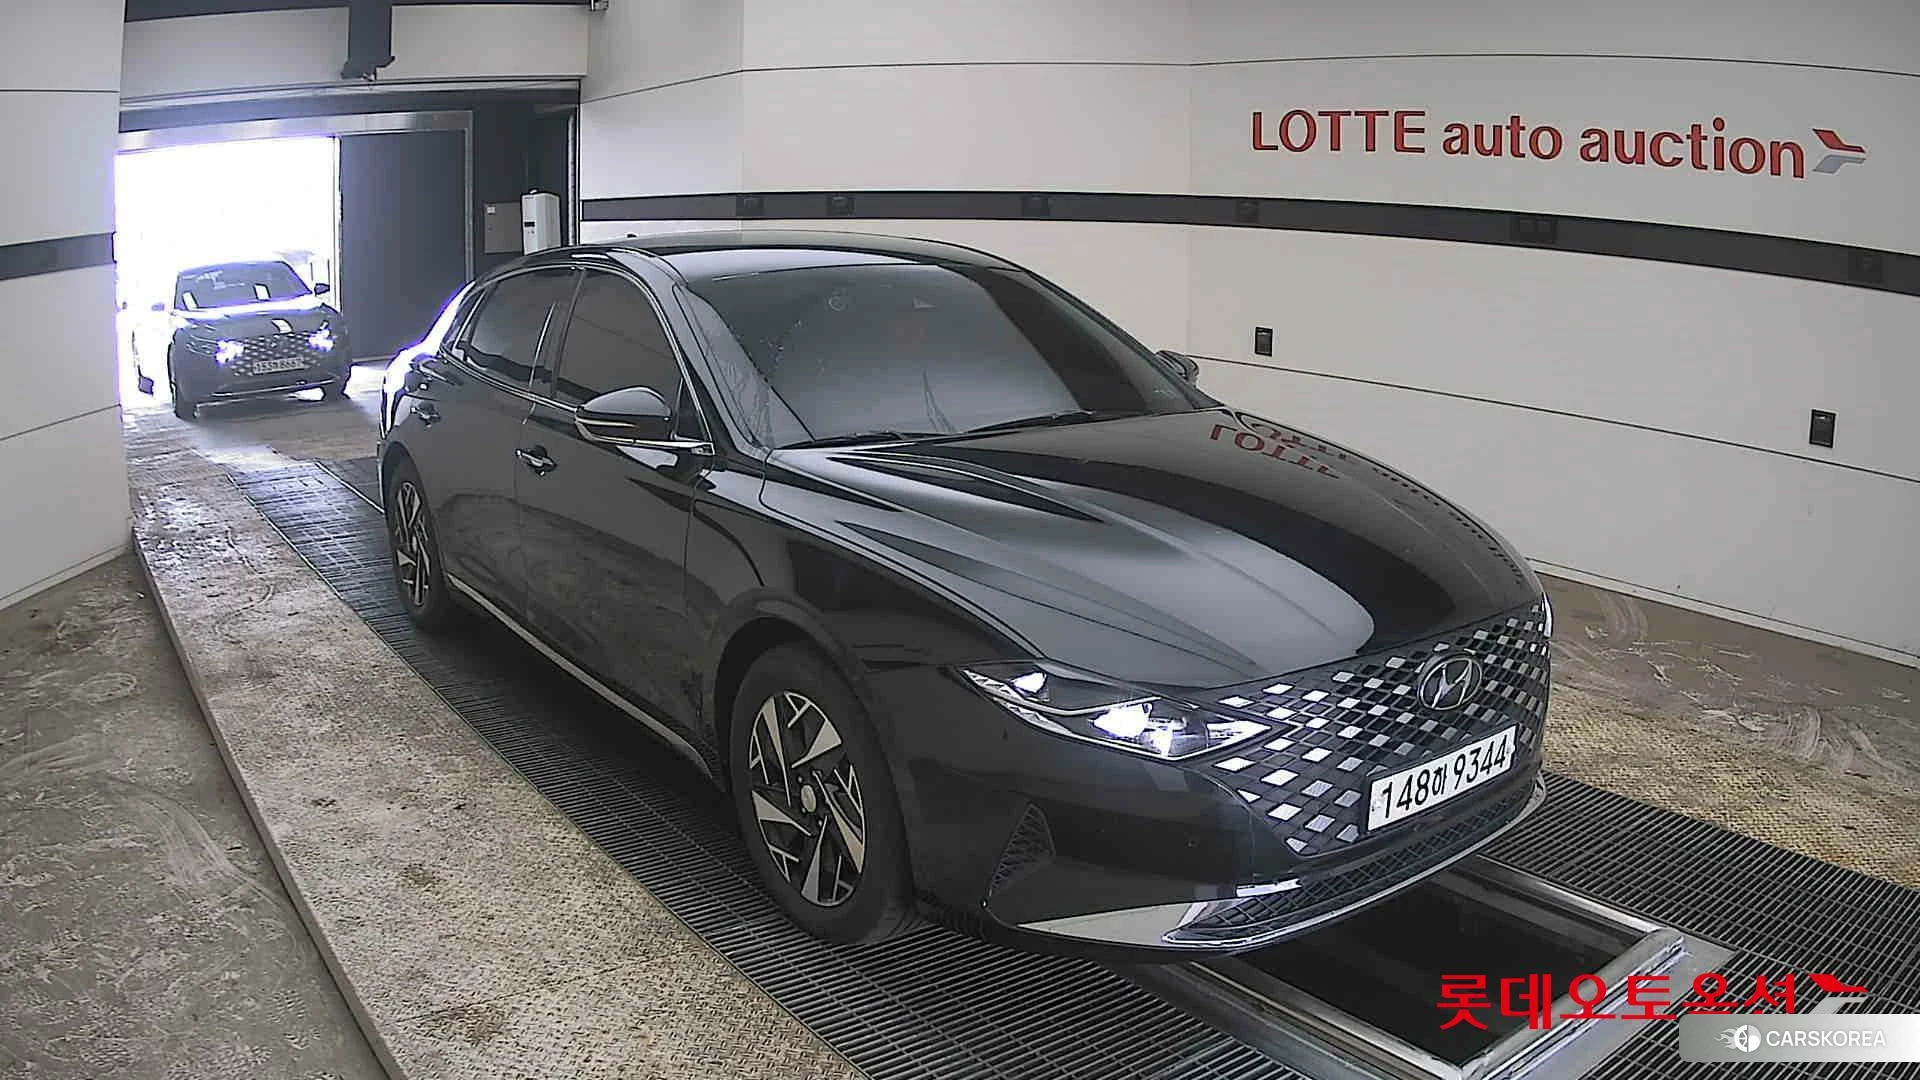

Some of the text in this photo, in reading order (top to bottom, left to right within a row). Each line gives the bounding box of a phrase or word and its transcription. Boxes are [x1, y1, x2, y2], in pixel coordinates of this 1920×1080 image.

[1251, 109, 1806, 179] LOTTE auto auction
[1382, 734, 1508, 819] 148하 9344
